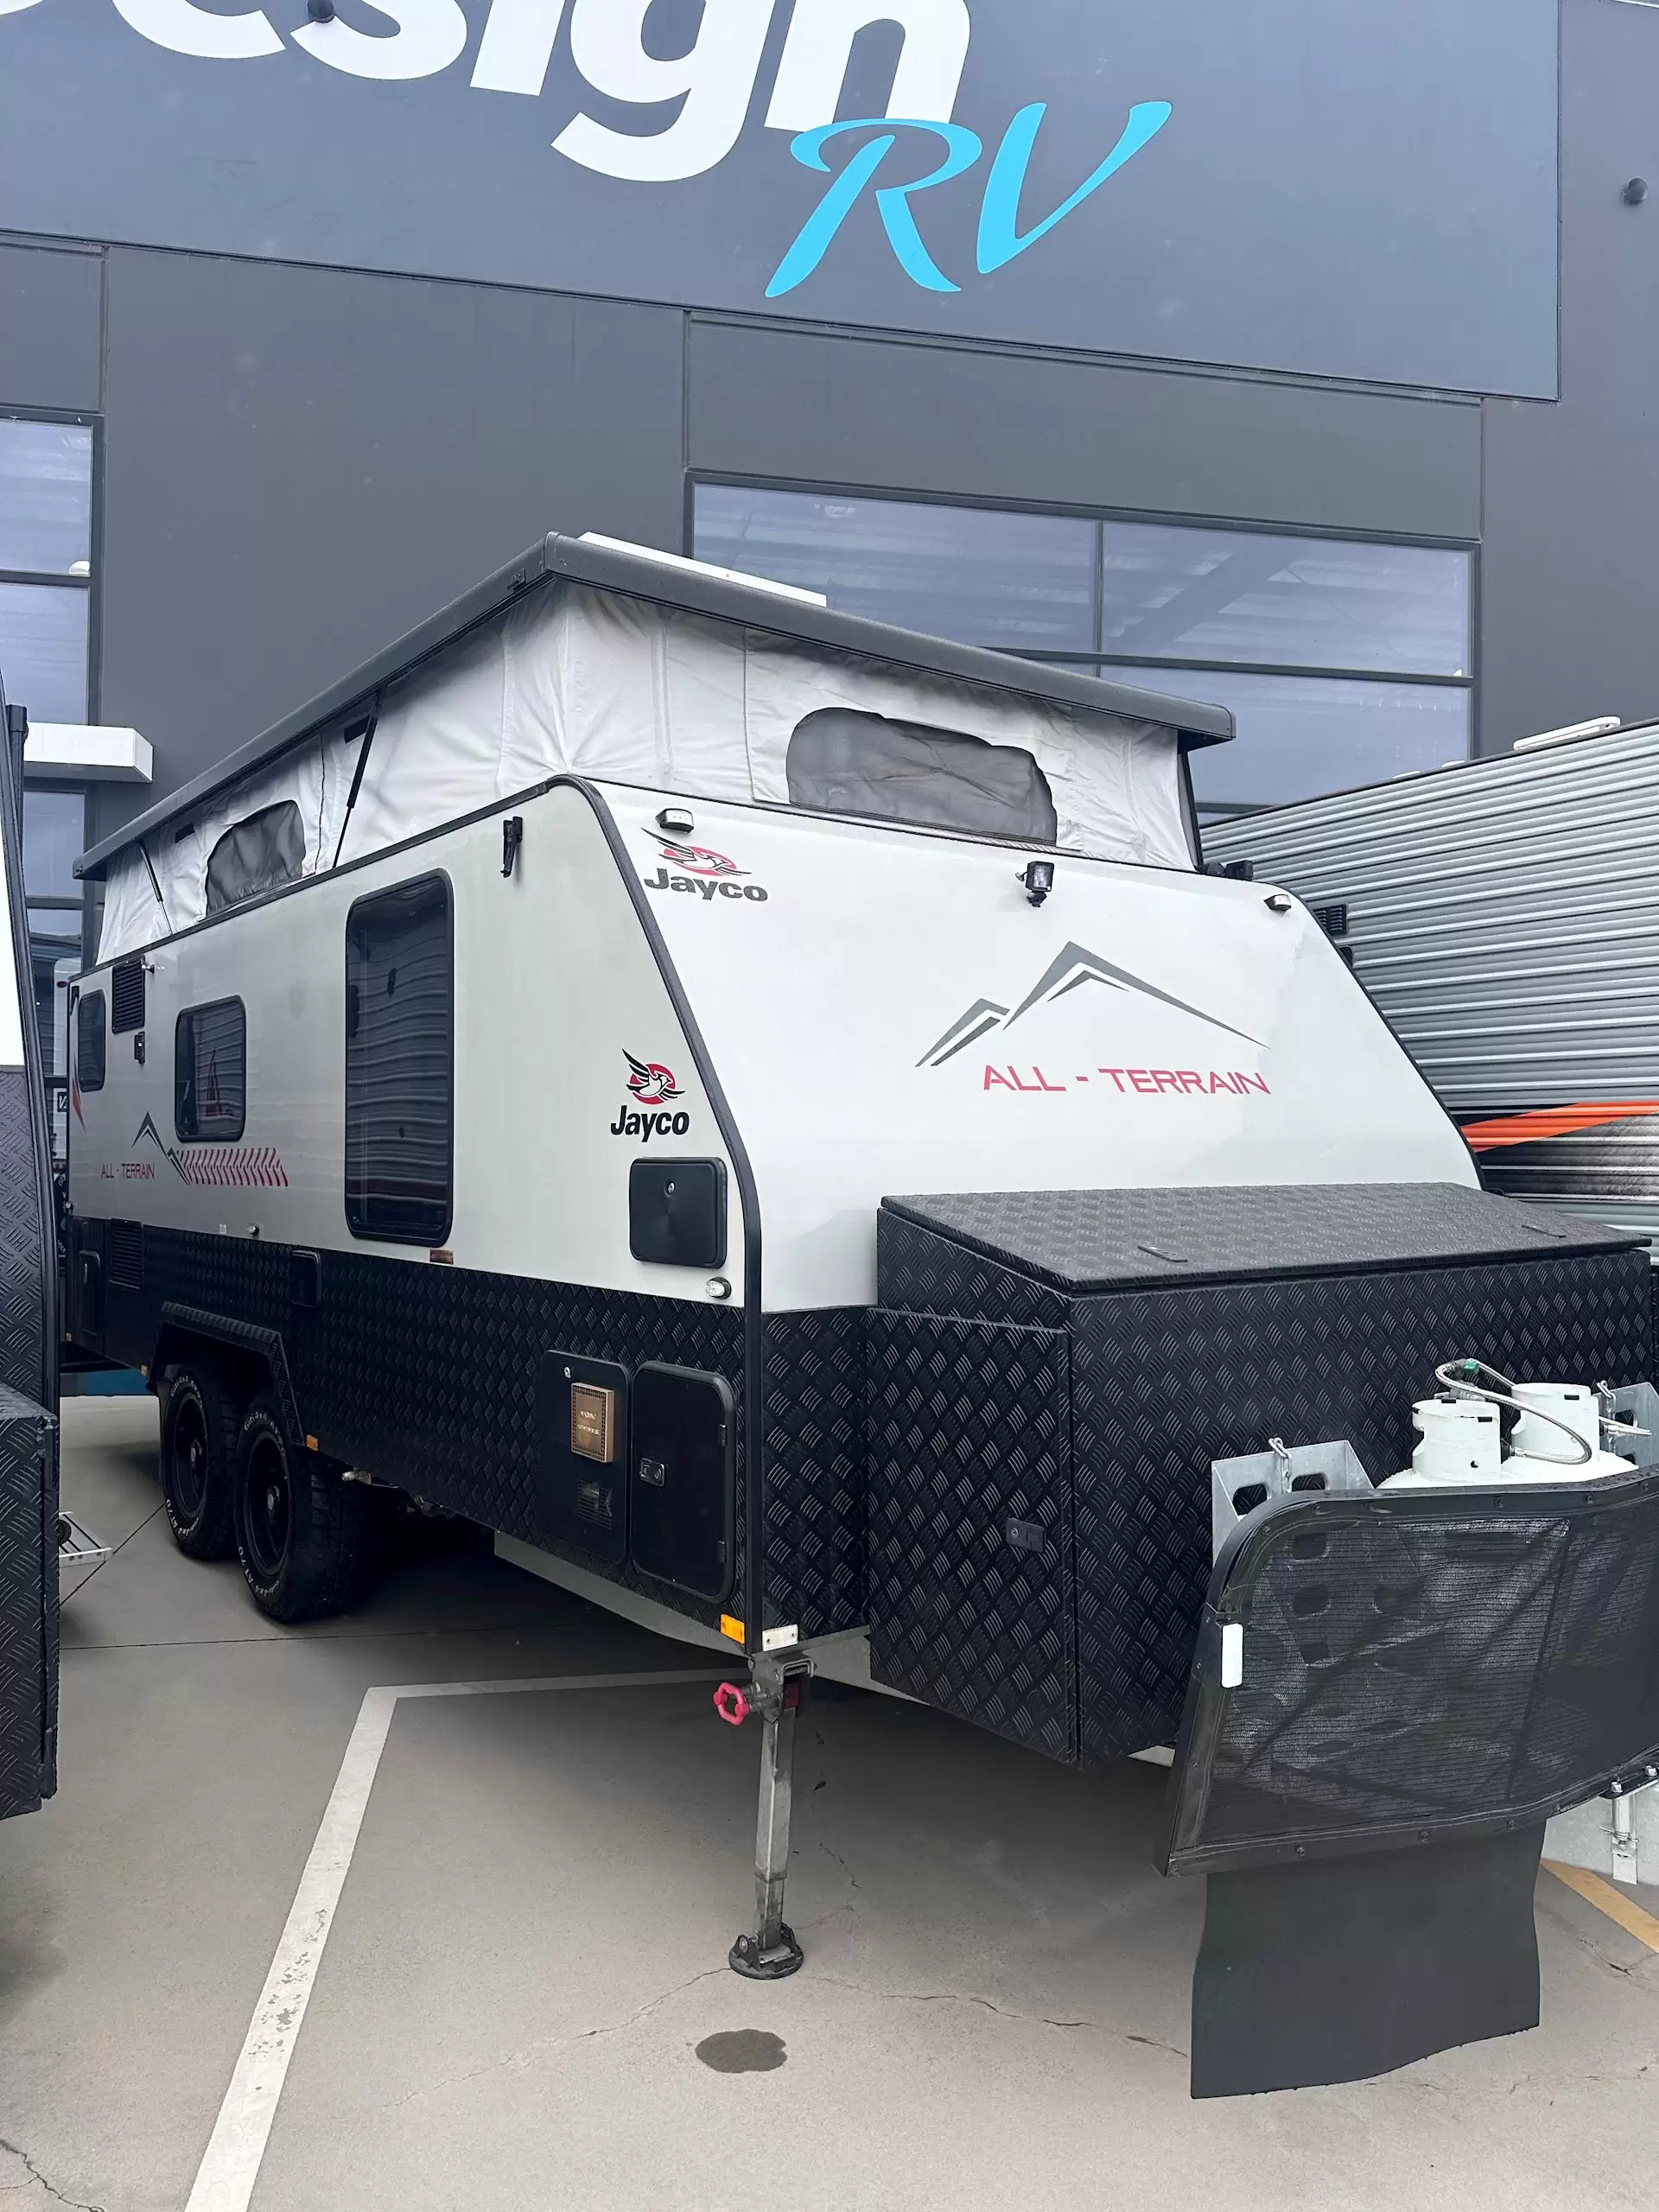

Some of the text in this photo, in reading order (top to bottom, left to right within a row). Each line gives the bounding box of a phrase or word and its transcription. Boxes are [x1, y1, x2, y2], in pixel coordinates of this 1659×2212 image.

[765, 99, 1173, 298] RV
[643, 868, 768, 902] Jayco
[983, 1065, 1067, 1092] ALL
[1097, 1068, 1272, 1095] TERRAIN
[610, 1104, 690, 1142] Jayco
[101, 1162, 114, 1179] ALL
[121, 1162, 155, 1179] TERRAIN
